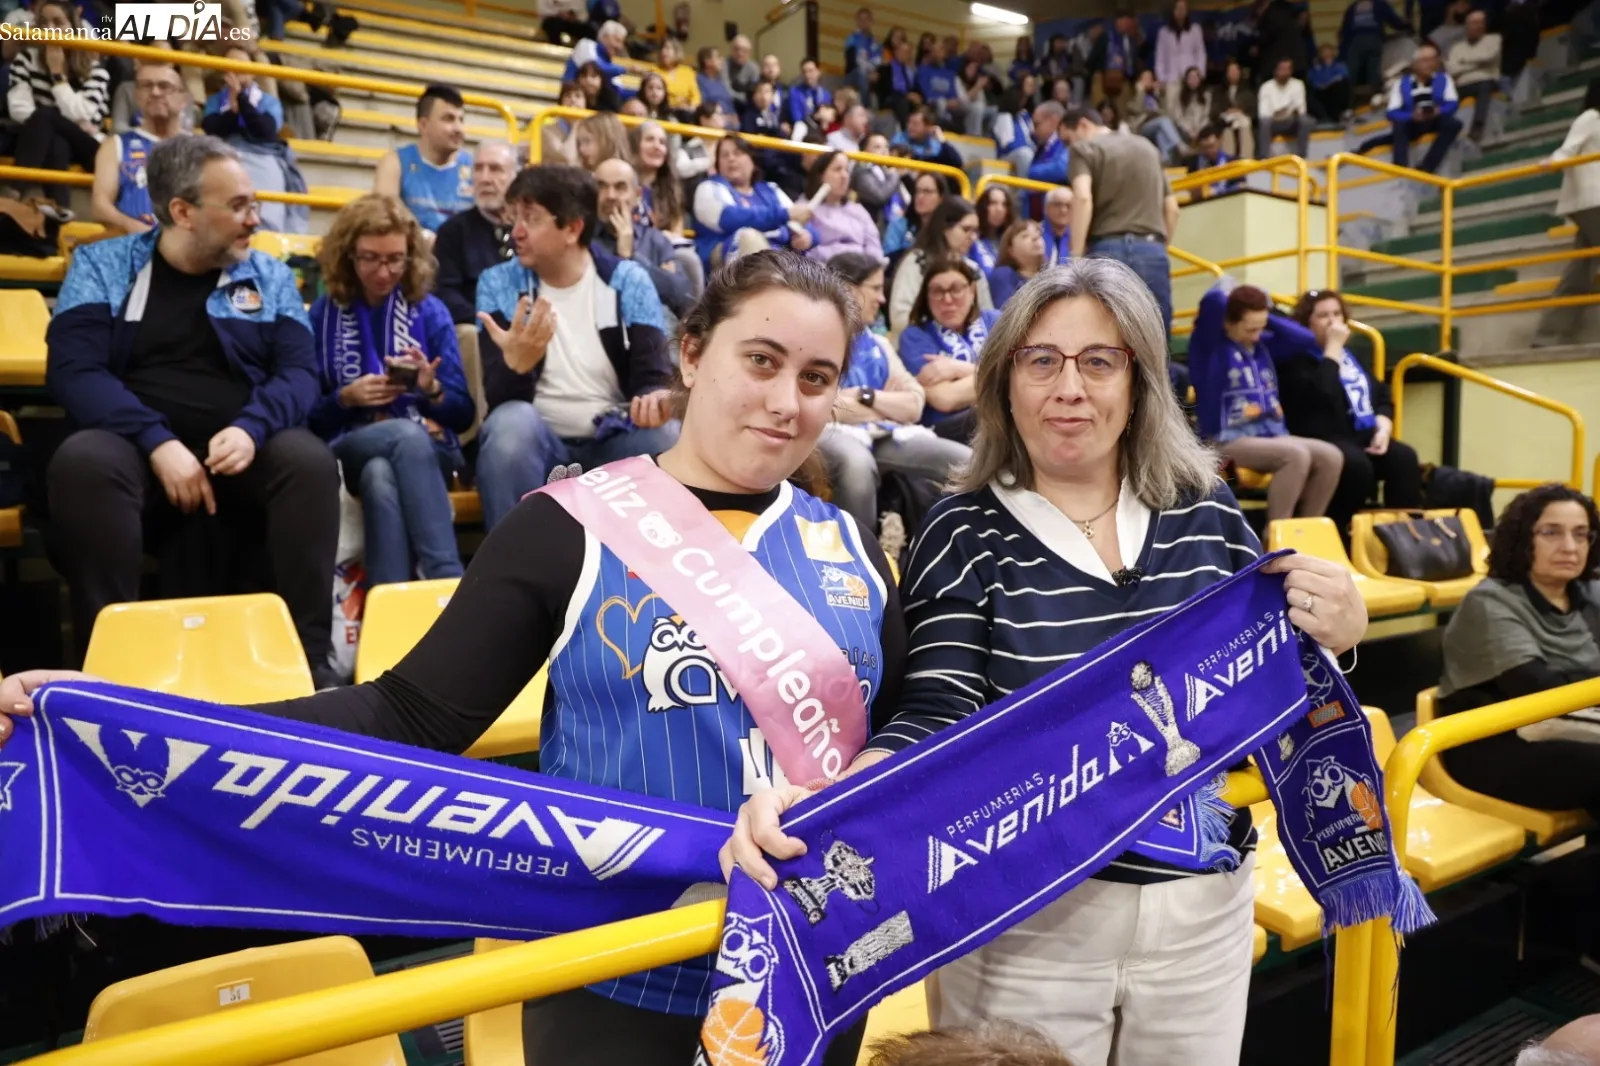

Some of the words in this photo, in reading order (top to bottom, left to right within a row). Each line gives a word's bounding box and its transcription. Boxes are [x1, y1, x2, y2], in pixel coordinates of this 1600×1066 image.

[341, 312, 361, 384] HALCO
[577, 466, 648, 518] eliz
[828, 593, 870, 610] AVENIDA
[1184, 609, 1296, 722] Aveni
[1197, 611, 1275, 675] PERFUMERIAS
[211, 750, 667, 881] Avenida
[927, 744, 1104, 894] Avenida
[946, 772, 1044, 838] PERFUMERIAS
[351, 827, 569, 877] PERFUMERIAS
